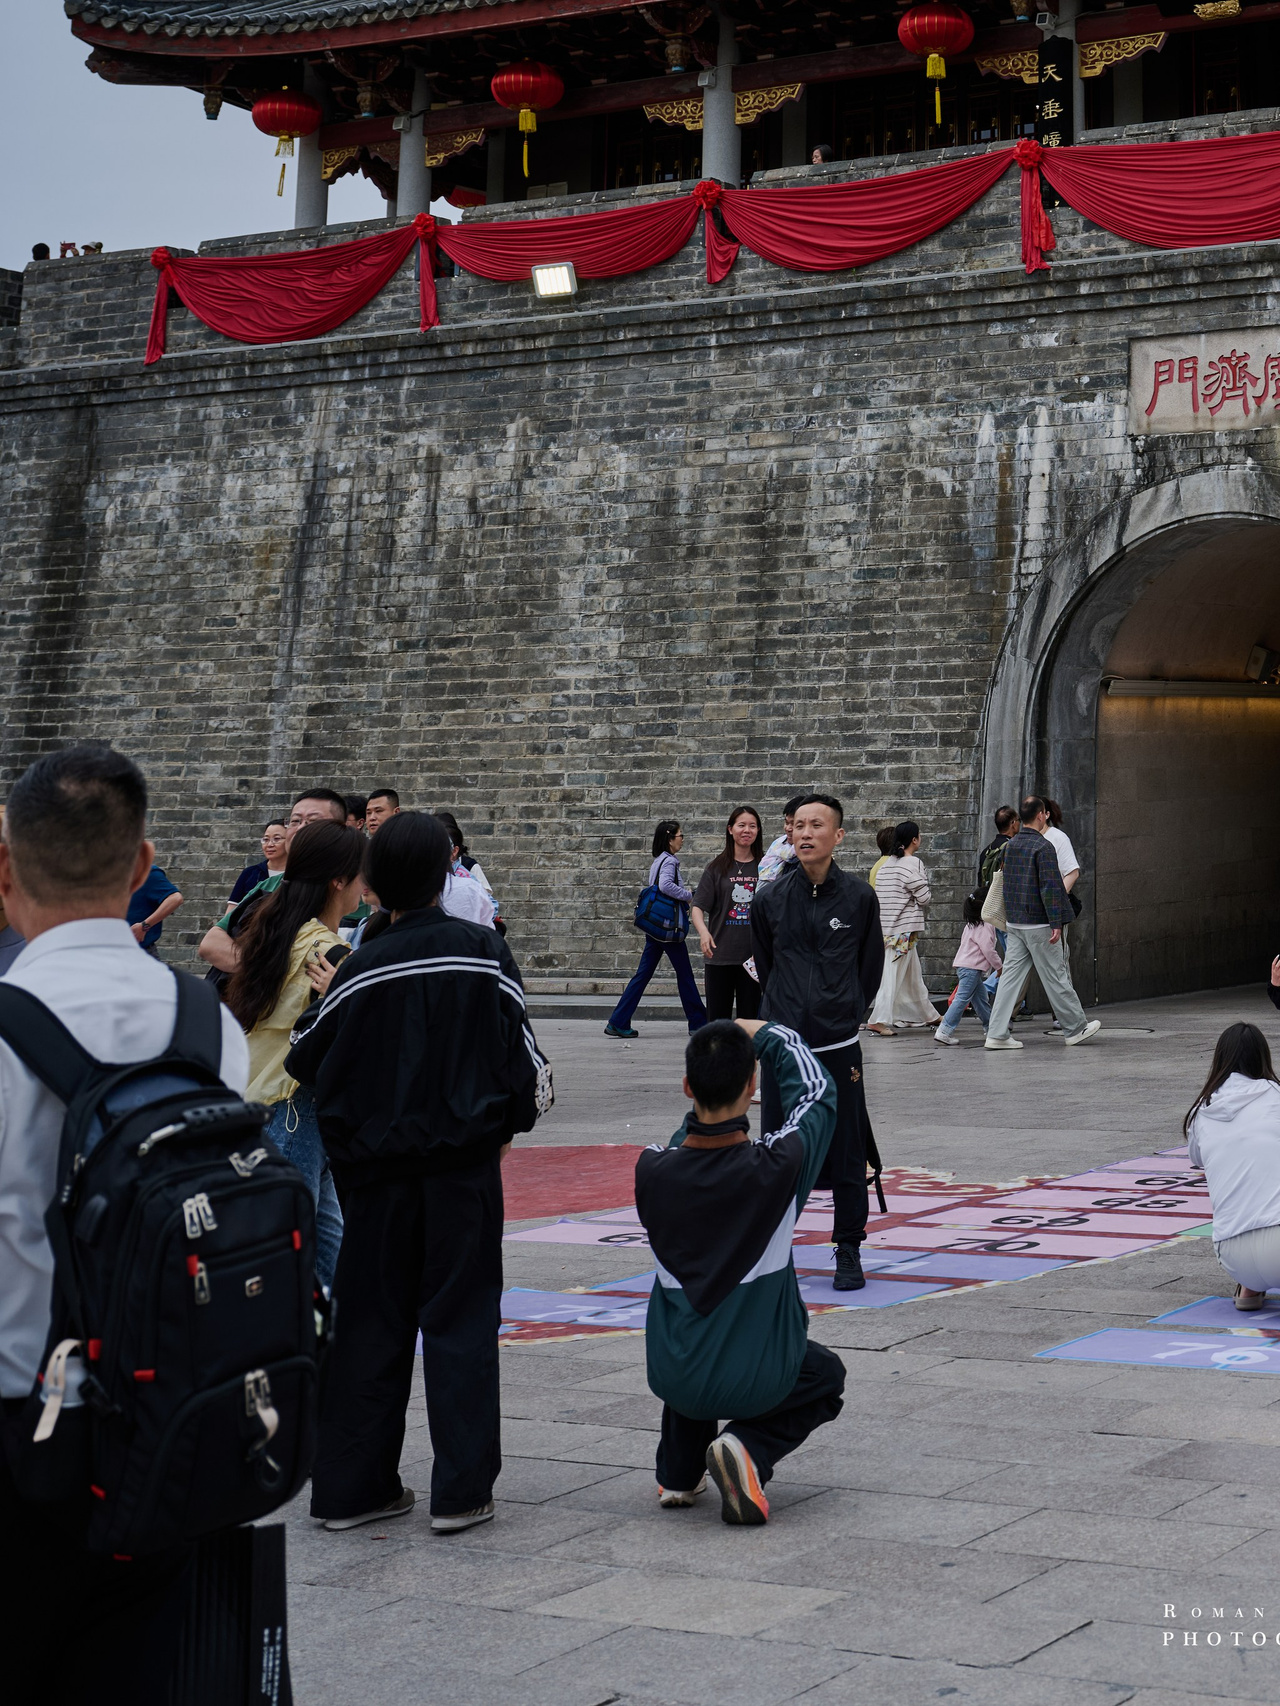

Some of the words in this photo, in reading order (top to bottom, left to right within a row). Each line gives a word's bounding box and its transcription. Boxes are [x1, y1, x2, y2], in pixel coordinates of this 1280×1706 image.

[1091, 1197, 1189, 1208] 68
[991, 1215, 1090, 1227] 69
[598, 1232, 651, 1245] 6
[936, 1238, 1041, 1252] 70
[526, 1304, 648, 1323] 73
[1151, 1341, 1280, 1365] 76
